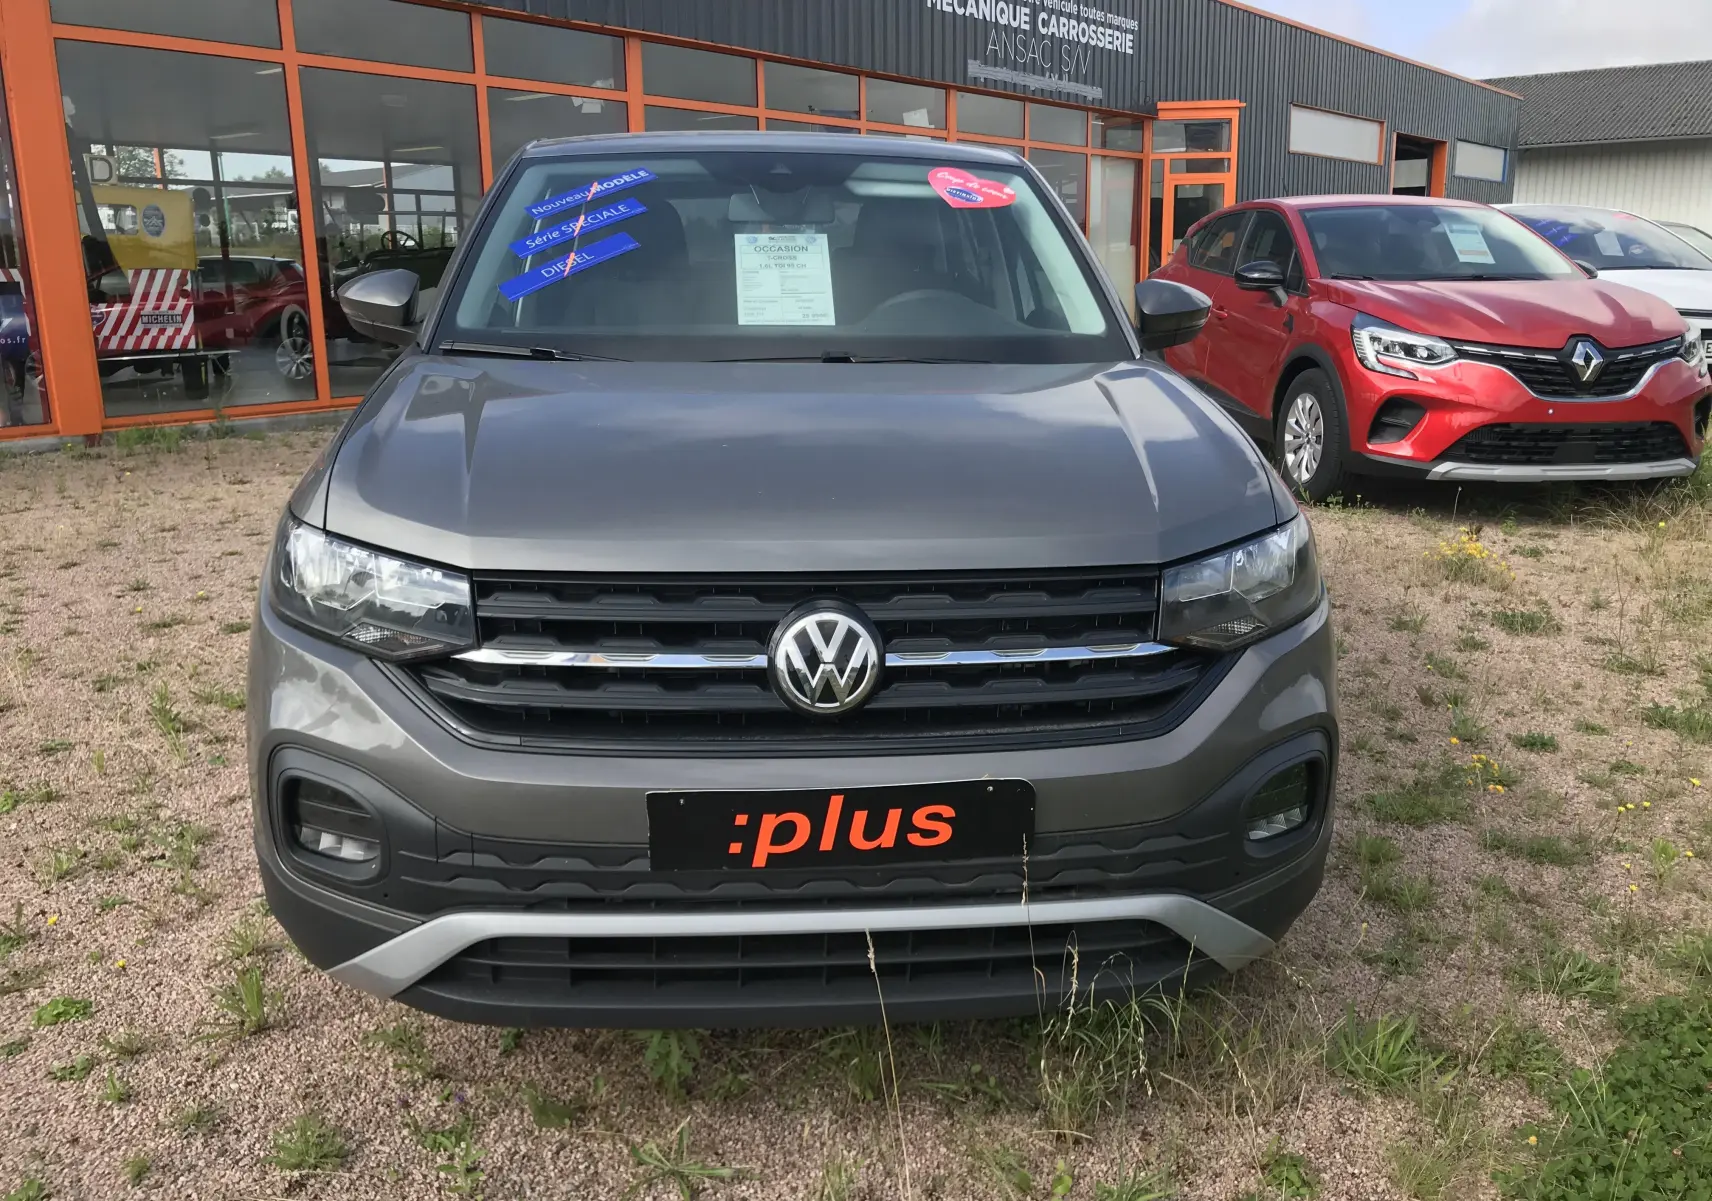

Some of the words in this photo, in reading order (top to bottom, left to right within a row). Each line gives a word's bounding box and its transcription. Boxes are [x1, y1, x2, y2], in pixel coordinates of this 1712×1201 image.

[1079, 4, 1105, 22] toutes
[1106, 12, 1139, 31] marques
[1037, 11, 1134, 55] CARROSSERIE
[986, 28, 1052, 68] ANSAC
[531, 190, 590, 215] Nouveau
[590, 169, 650, 194] MODÈLE
[525, 229, 561, 249] Série
[753, 245, 809, 253] OCCASION
[540, 251, 595, 278] DIESEL
[141, 315, 182, 324] MICHELIN
